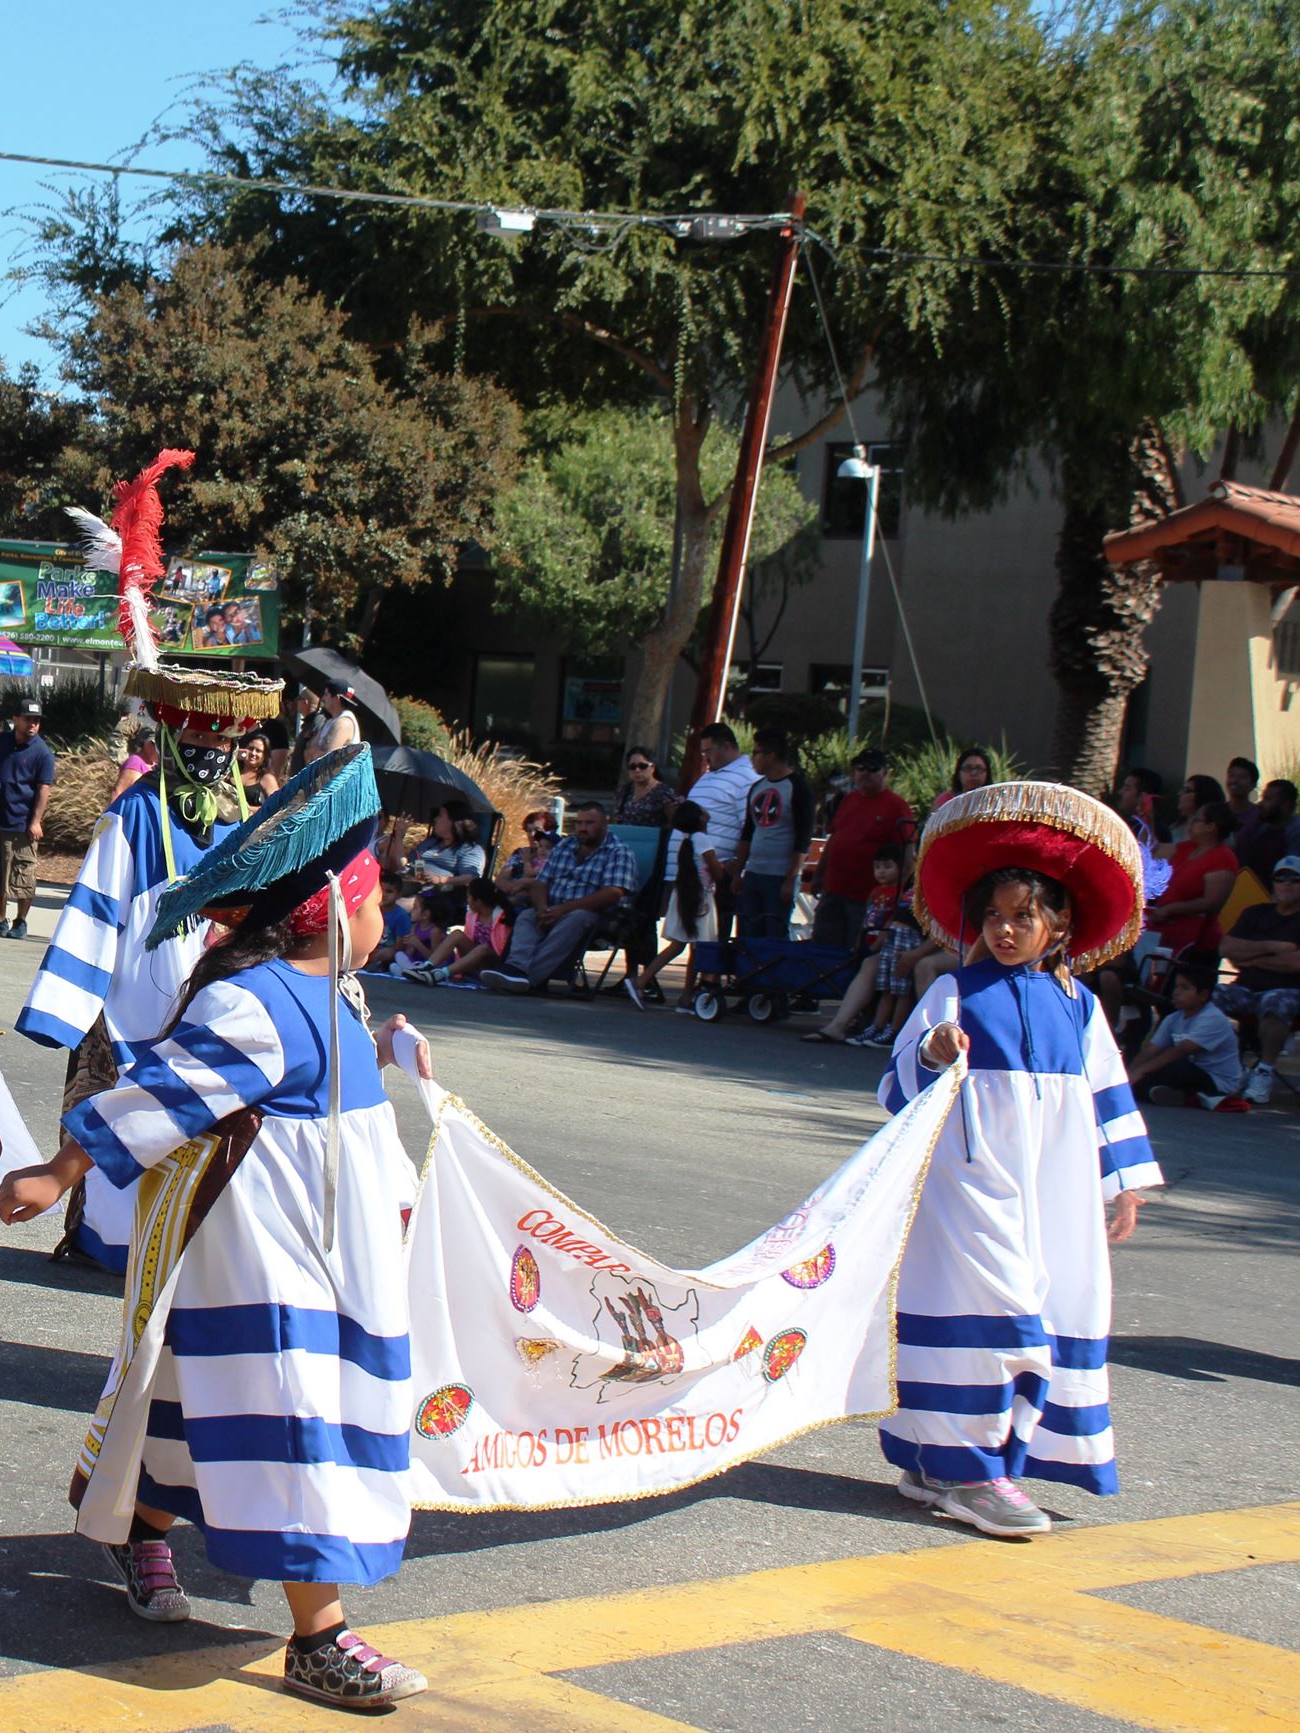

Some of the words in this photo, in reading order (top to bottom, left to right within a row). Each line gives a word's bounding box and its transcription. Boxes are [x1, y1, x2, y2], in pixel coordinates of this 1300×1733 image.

[38, 561, 97, 586] Parks
[37, 580, 95, 600] Make
[45, 597, 85, 617] Life
[460, 1429, 548, 1474] AMIGOS
[555, 1427, 589, 1465] DE
[597, 1408, 744, 1461] MORELOS
